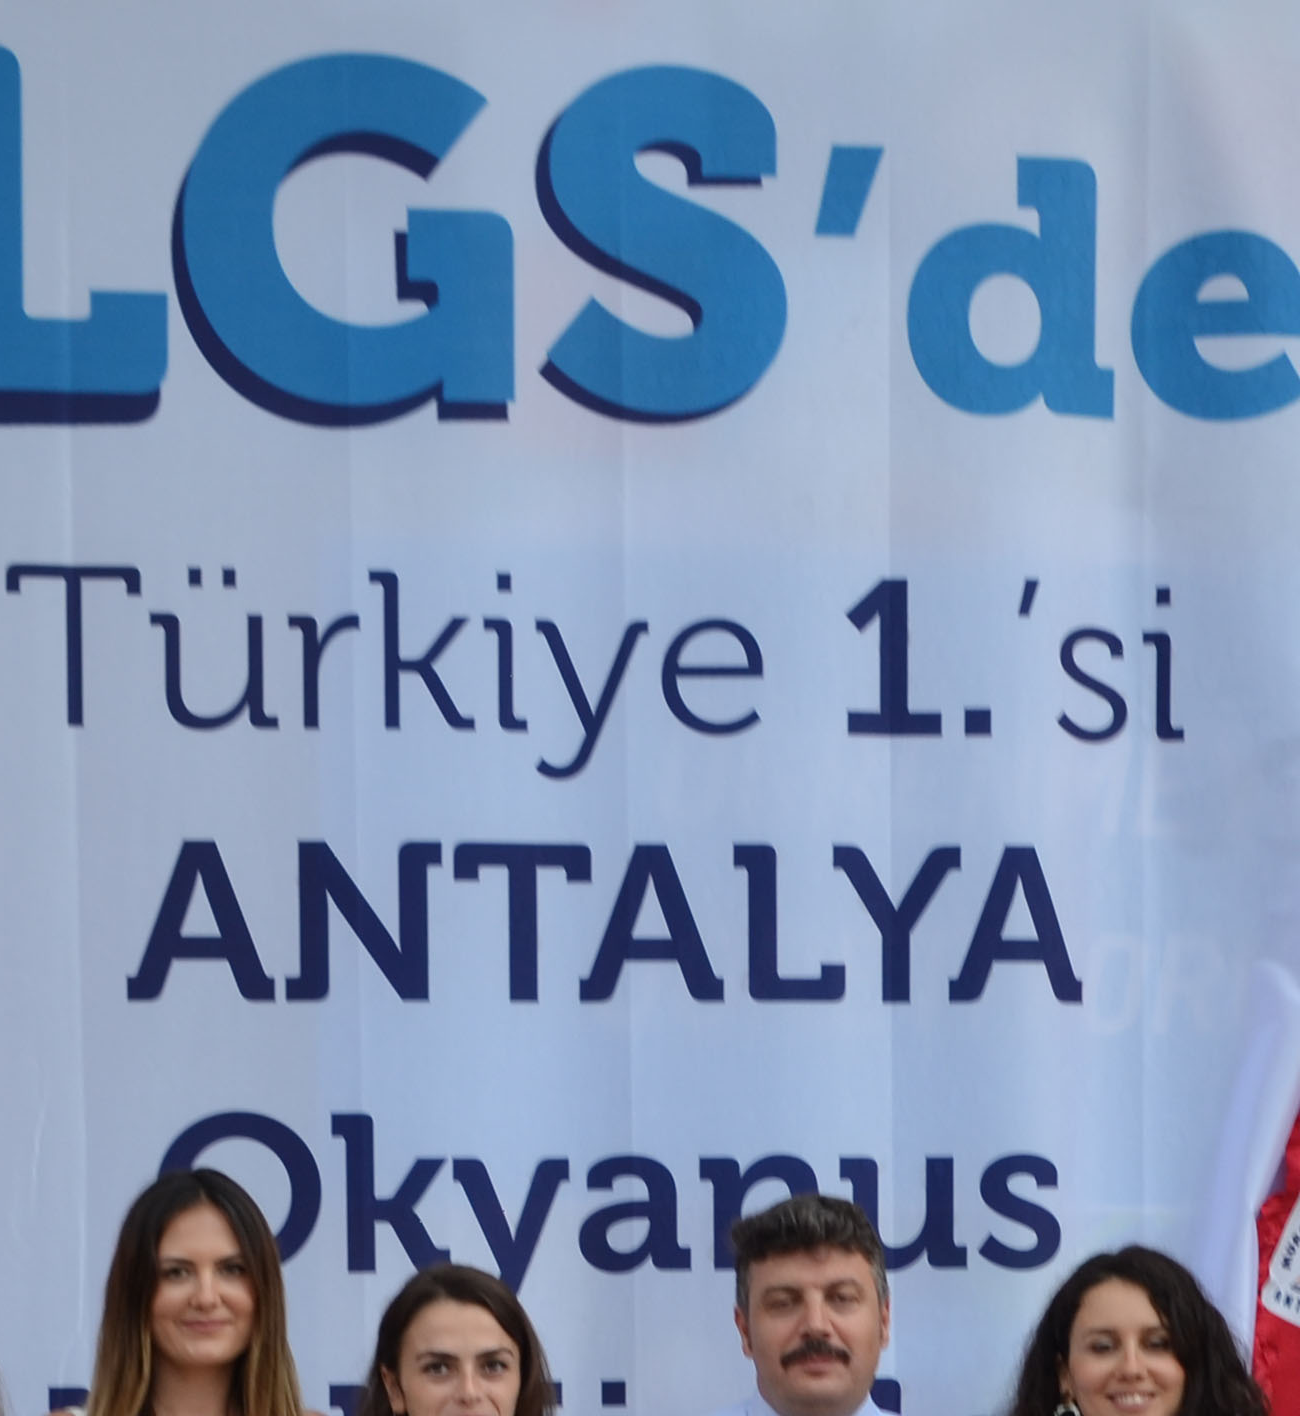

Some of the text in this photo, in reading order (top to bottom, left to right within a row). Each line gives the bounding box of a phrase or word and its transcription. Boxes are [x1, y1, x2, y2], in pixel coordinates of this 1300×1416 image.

[6, 565, 763, 778] Türkiye
[127, 841, 1082, 1002] ANTALYA
[156, 1110, 1062, 1292] Okyanus
